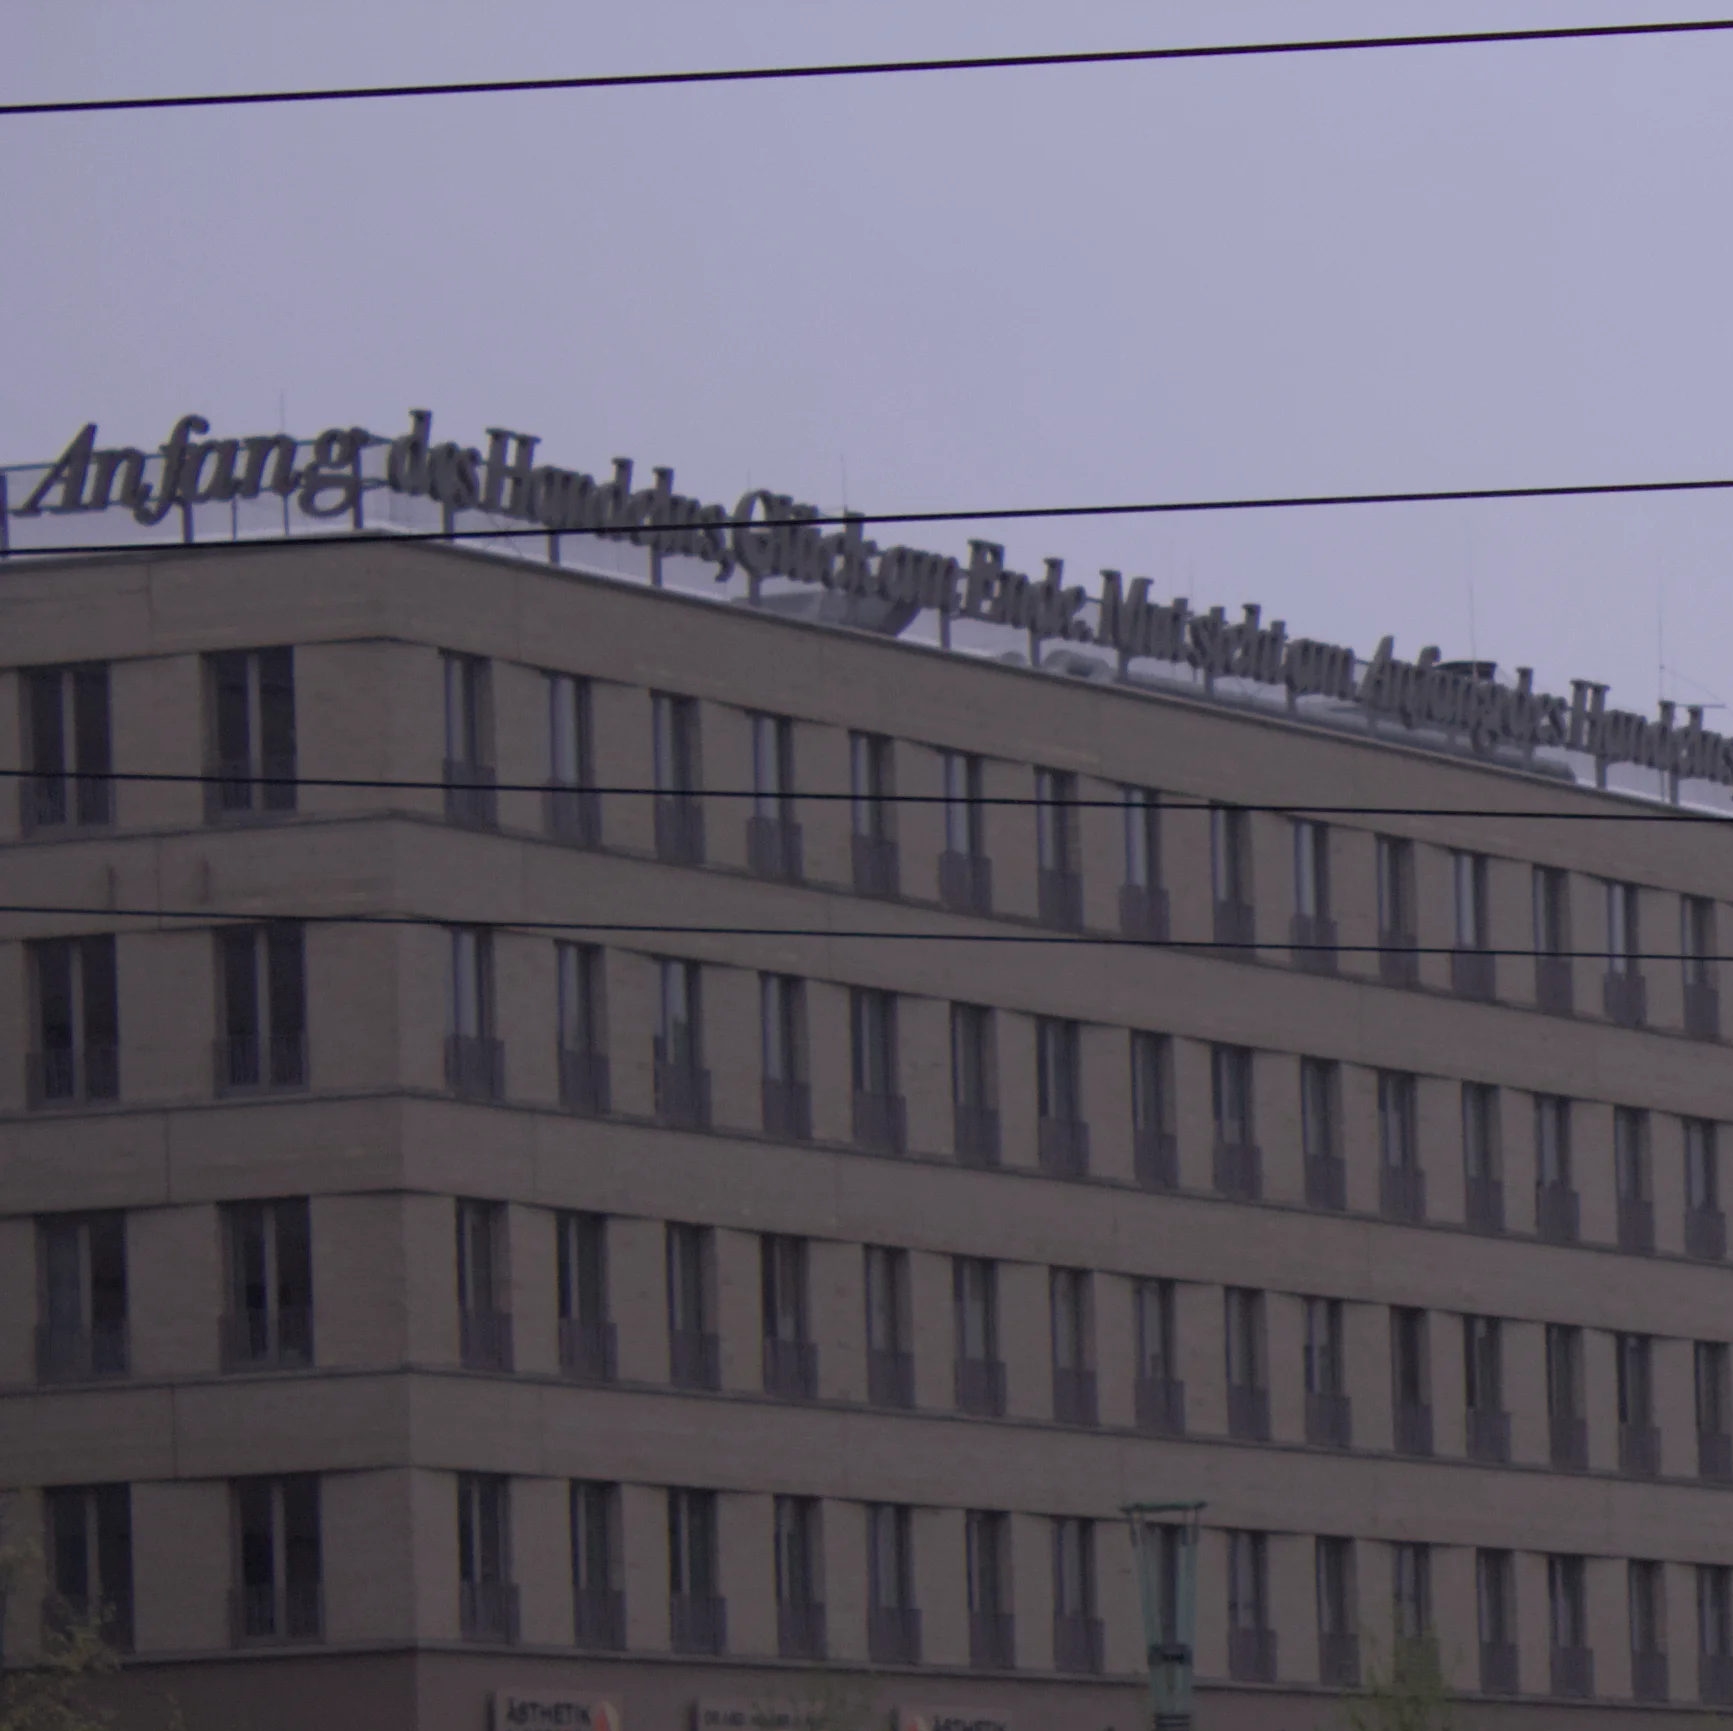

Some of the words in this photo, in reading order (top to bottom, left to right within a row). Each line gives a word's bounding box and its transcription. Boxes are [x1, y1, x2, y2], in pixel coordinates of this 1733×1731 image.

[8, 414, 372, 526] Anfang
[386, 408, 482, 509] des
[733, 489, 880, 597] Glück
[878, 545, 962, 616] am
[1093, 568, 1193, 662] Mut
[1187, 603, 1289, 684] steht
[1285, 638, 1357, 700] am
[1354, 635, 1510, 754] Anfang
[1503, 667, 1568, 748] des
